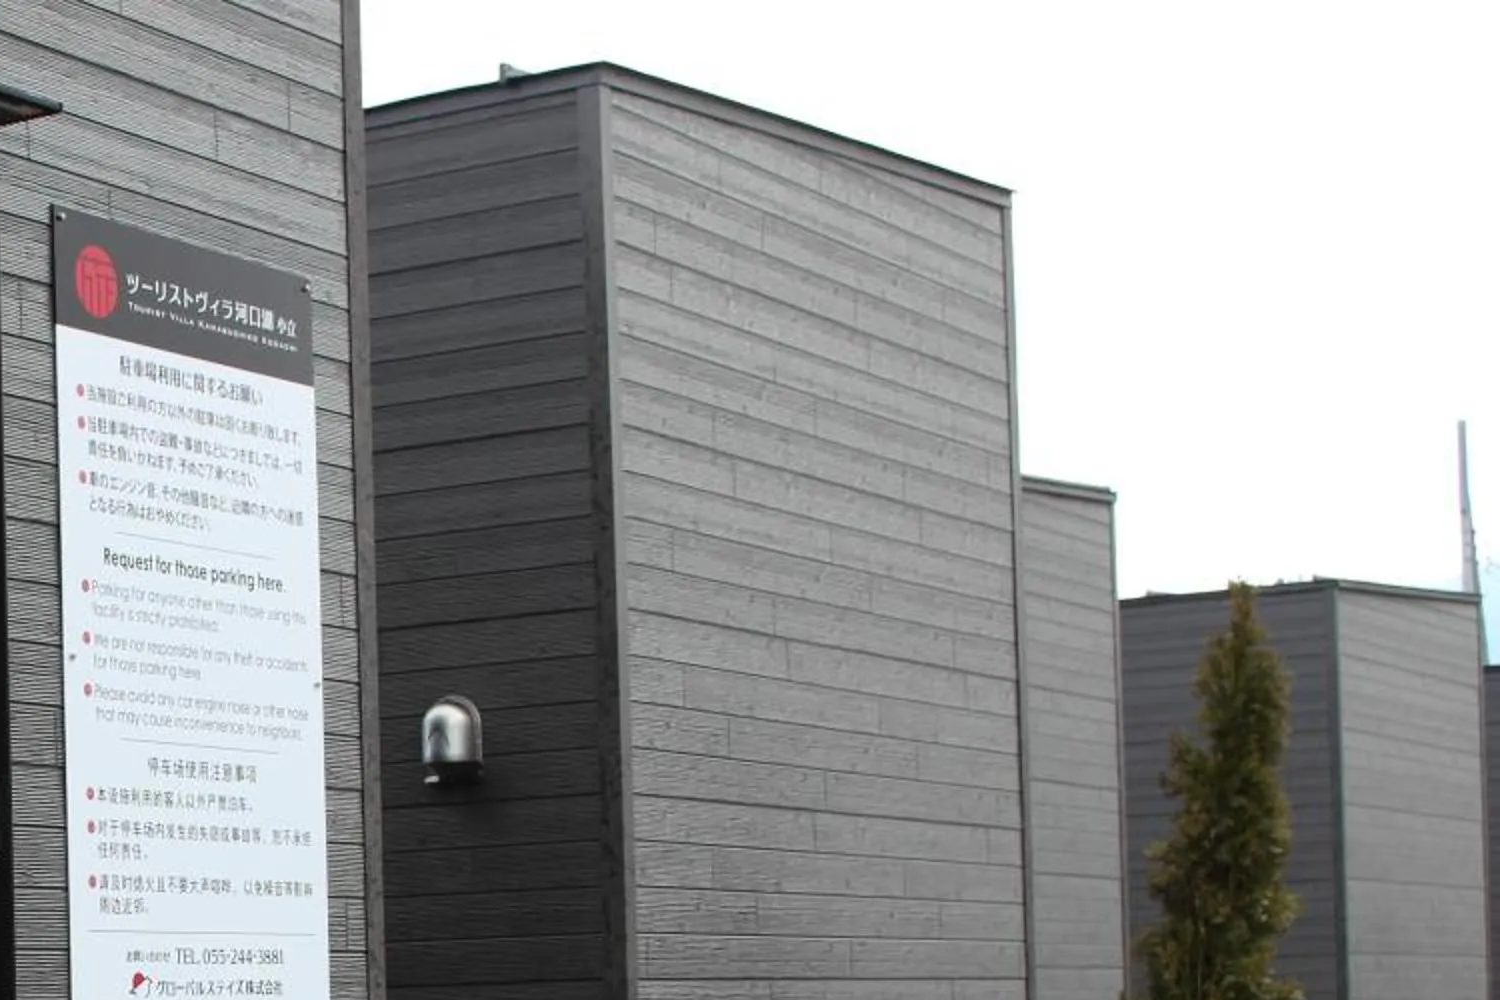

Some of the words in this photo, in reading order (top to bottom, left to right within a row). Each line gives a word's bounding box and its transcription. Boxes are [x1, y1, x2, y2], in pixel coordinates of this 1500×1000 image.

[126, 273, 274, 331] ツーリストヴィラ河口湖
[103, 548, 153, 572] Request
[155, 555, 171, 574] for
[175, 559, 207, 580] those
[211, 567, 254, 592] parking
[257, 573, 287, 593] here.
